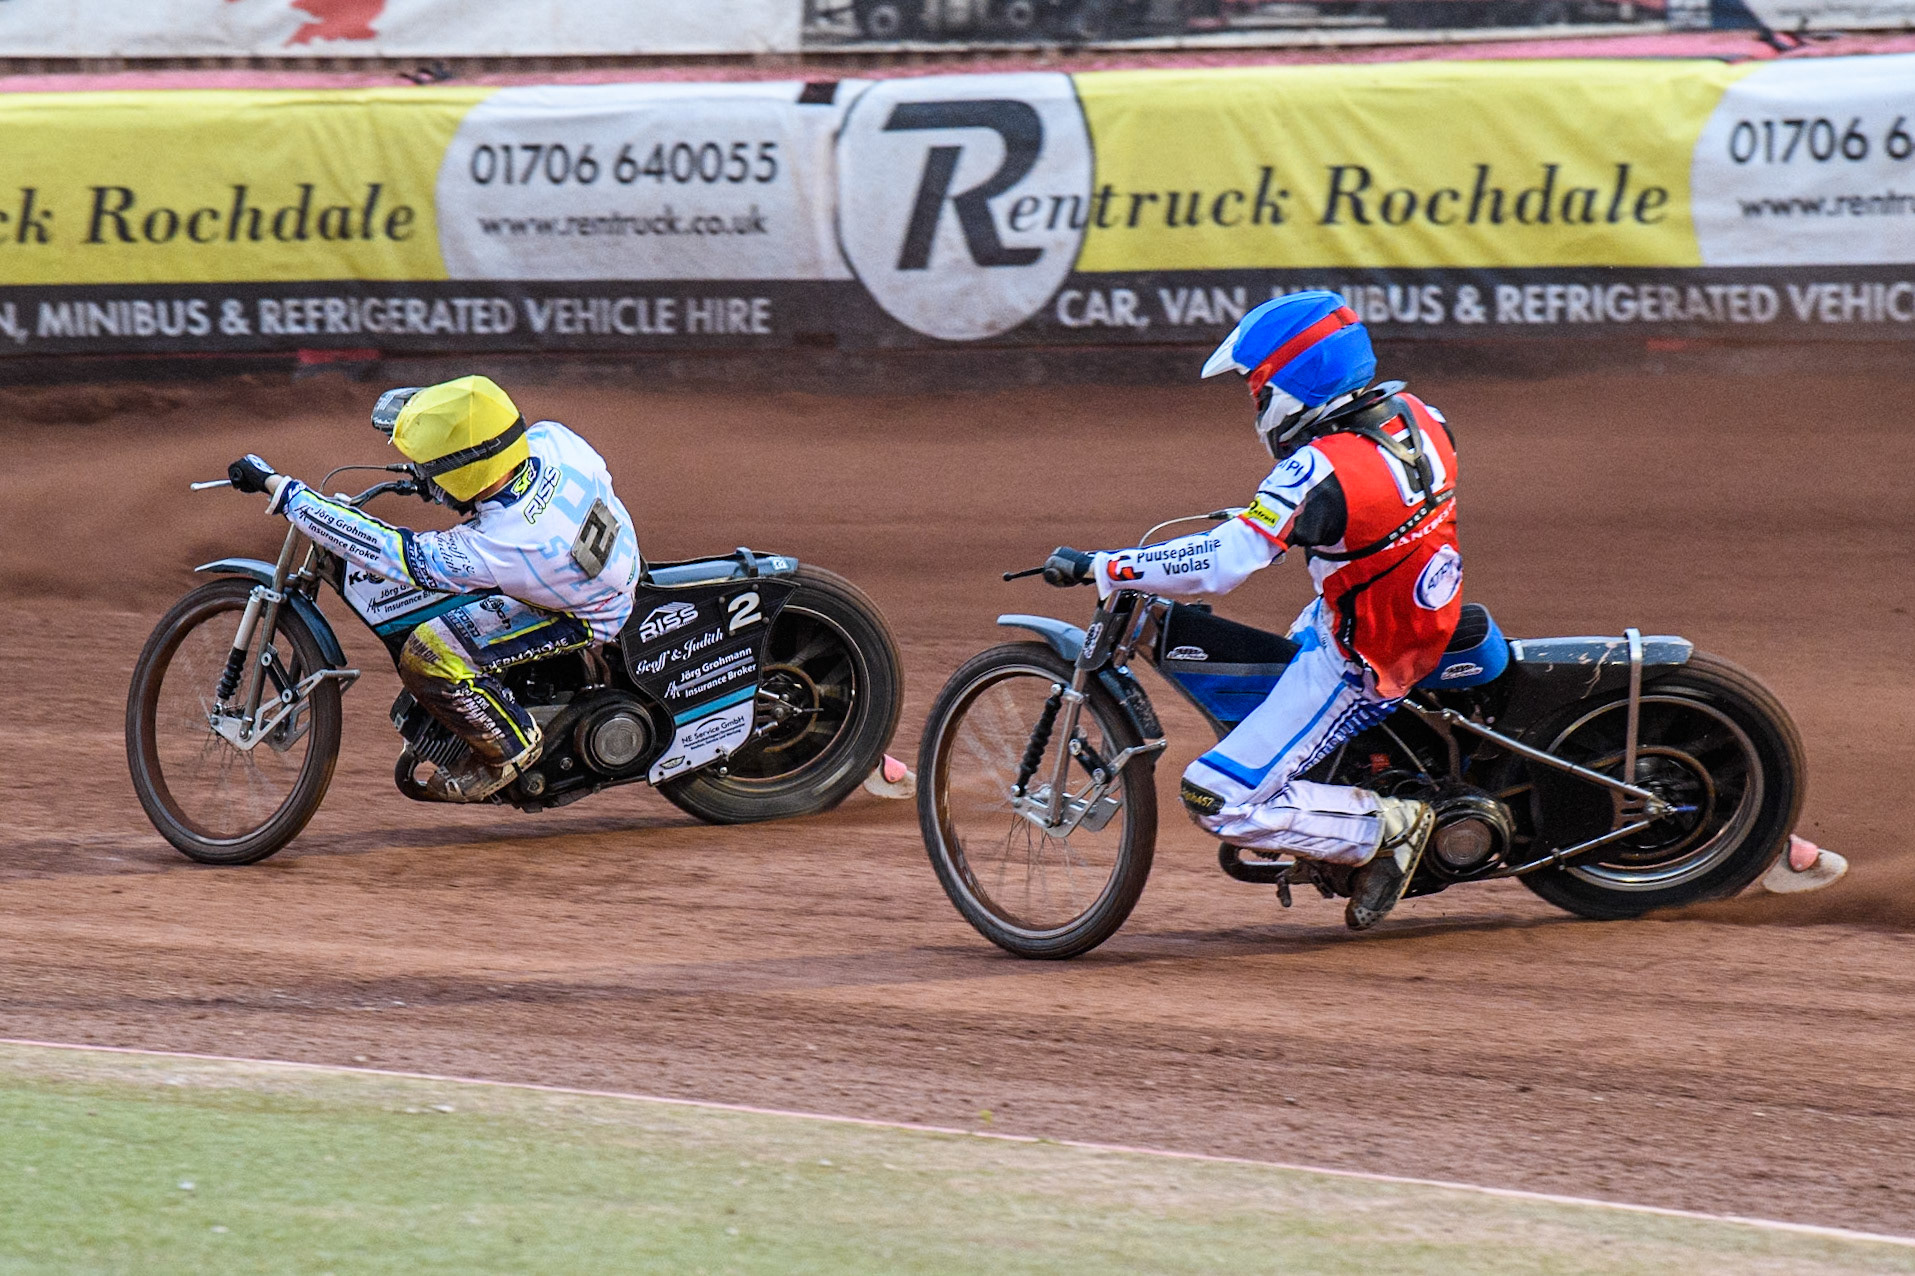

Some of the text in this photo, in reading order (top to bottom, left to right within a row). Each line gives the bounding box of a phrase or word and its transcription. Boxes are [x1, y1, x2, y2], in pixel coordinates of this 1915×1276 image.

[1730, 115, 1915, 163] 01706 6
[471, 141, 779, 186] 01706 640055
[1316, 162, 1670, 227] Rochdale
[1737, 189, 1915, 216] www.rentr
[80, 184, 416, 245] Rochdale
[477, 204, 769, 236] www.rentruck.co.uk
[37, 299, 205, 337] MINIBUS
[219, 298, 253, 336] &
[258, 297, 517, 337] REFRIGERATED
[523, 297, 678, 335] VEHICLE
[685, 297, 773, 335] HIRE
[1453, 285, 1489, 324] &
[1498, 283, 1780, 325] REFRIGERATED
[524, 466, 562, 525] RISS
[313, 507, 335, 525] Jörg
[308, 522, 380, 562] Insurance Broker
[579, 509, 615, 567] 2
[1162, 557, 1211, 576] Vuolas
[380, 584, 400, 599] Jörg
[384, 595, 422, 613] Insurance
[639, 605, 699, 644] RISS
[727, 591, 763, 633] 2
[670, 648, 683, 662] &
[682, 627, 724, 661] Judith
[680, 647, 753, 683] Jörg Grohmann
[685, 663, 757, 698] Insurance Broker
[681, 734, 693, 744] NE
[694, 726, 720, 740] Service
[720, 715, 745, 731] GmbH
